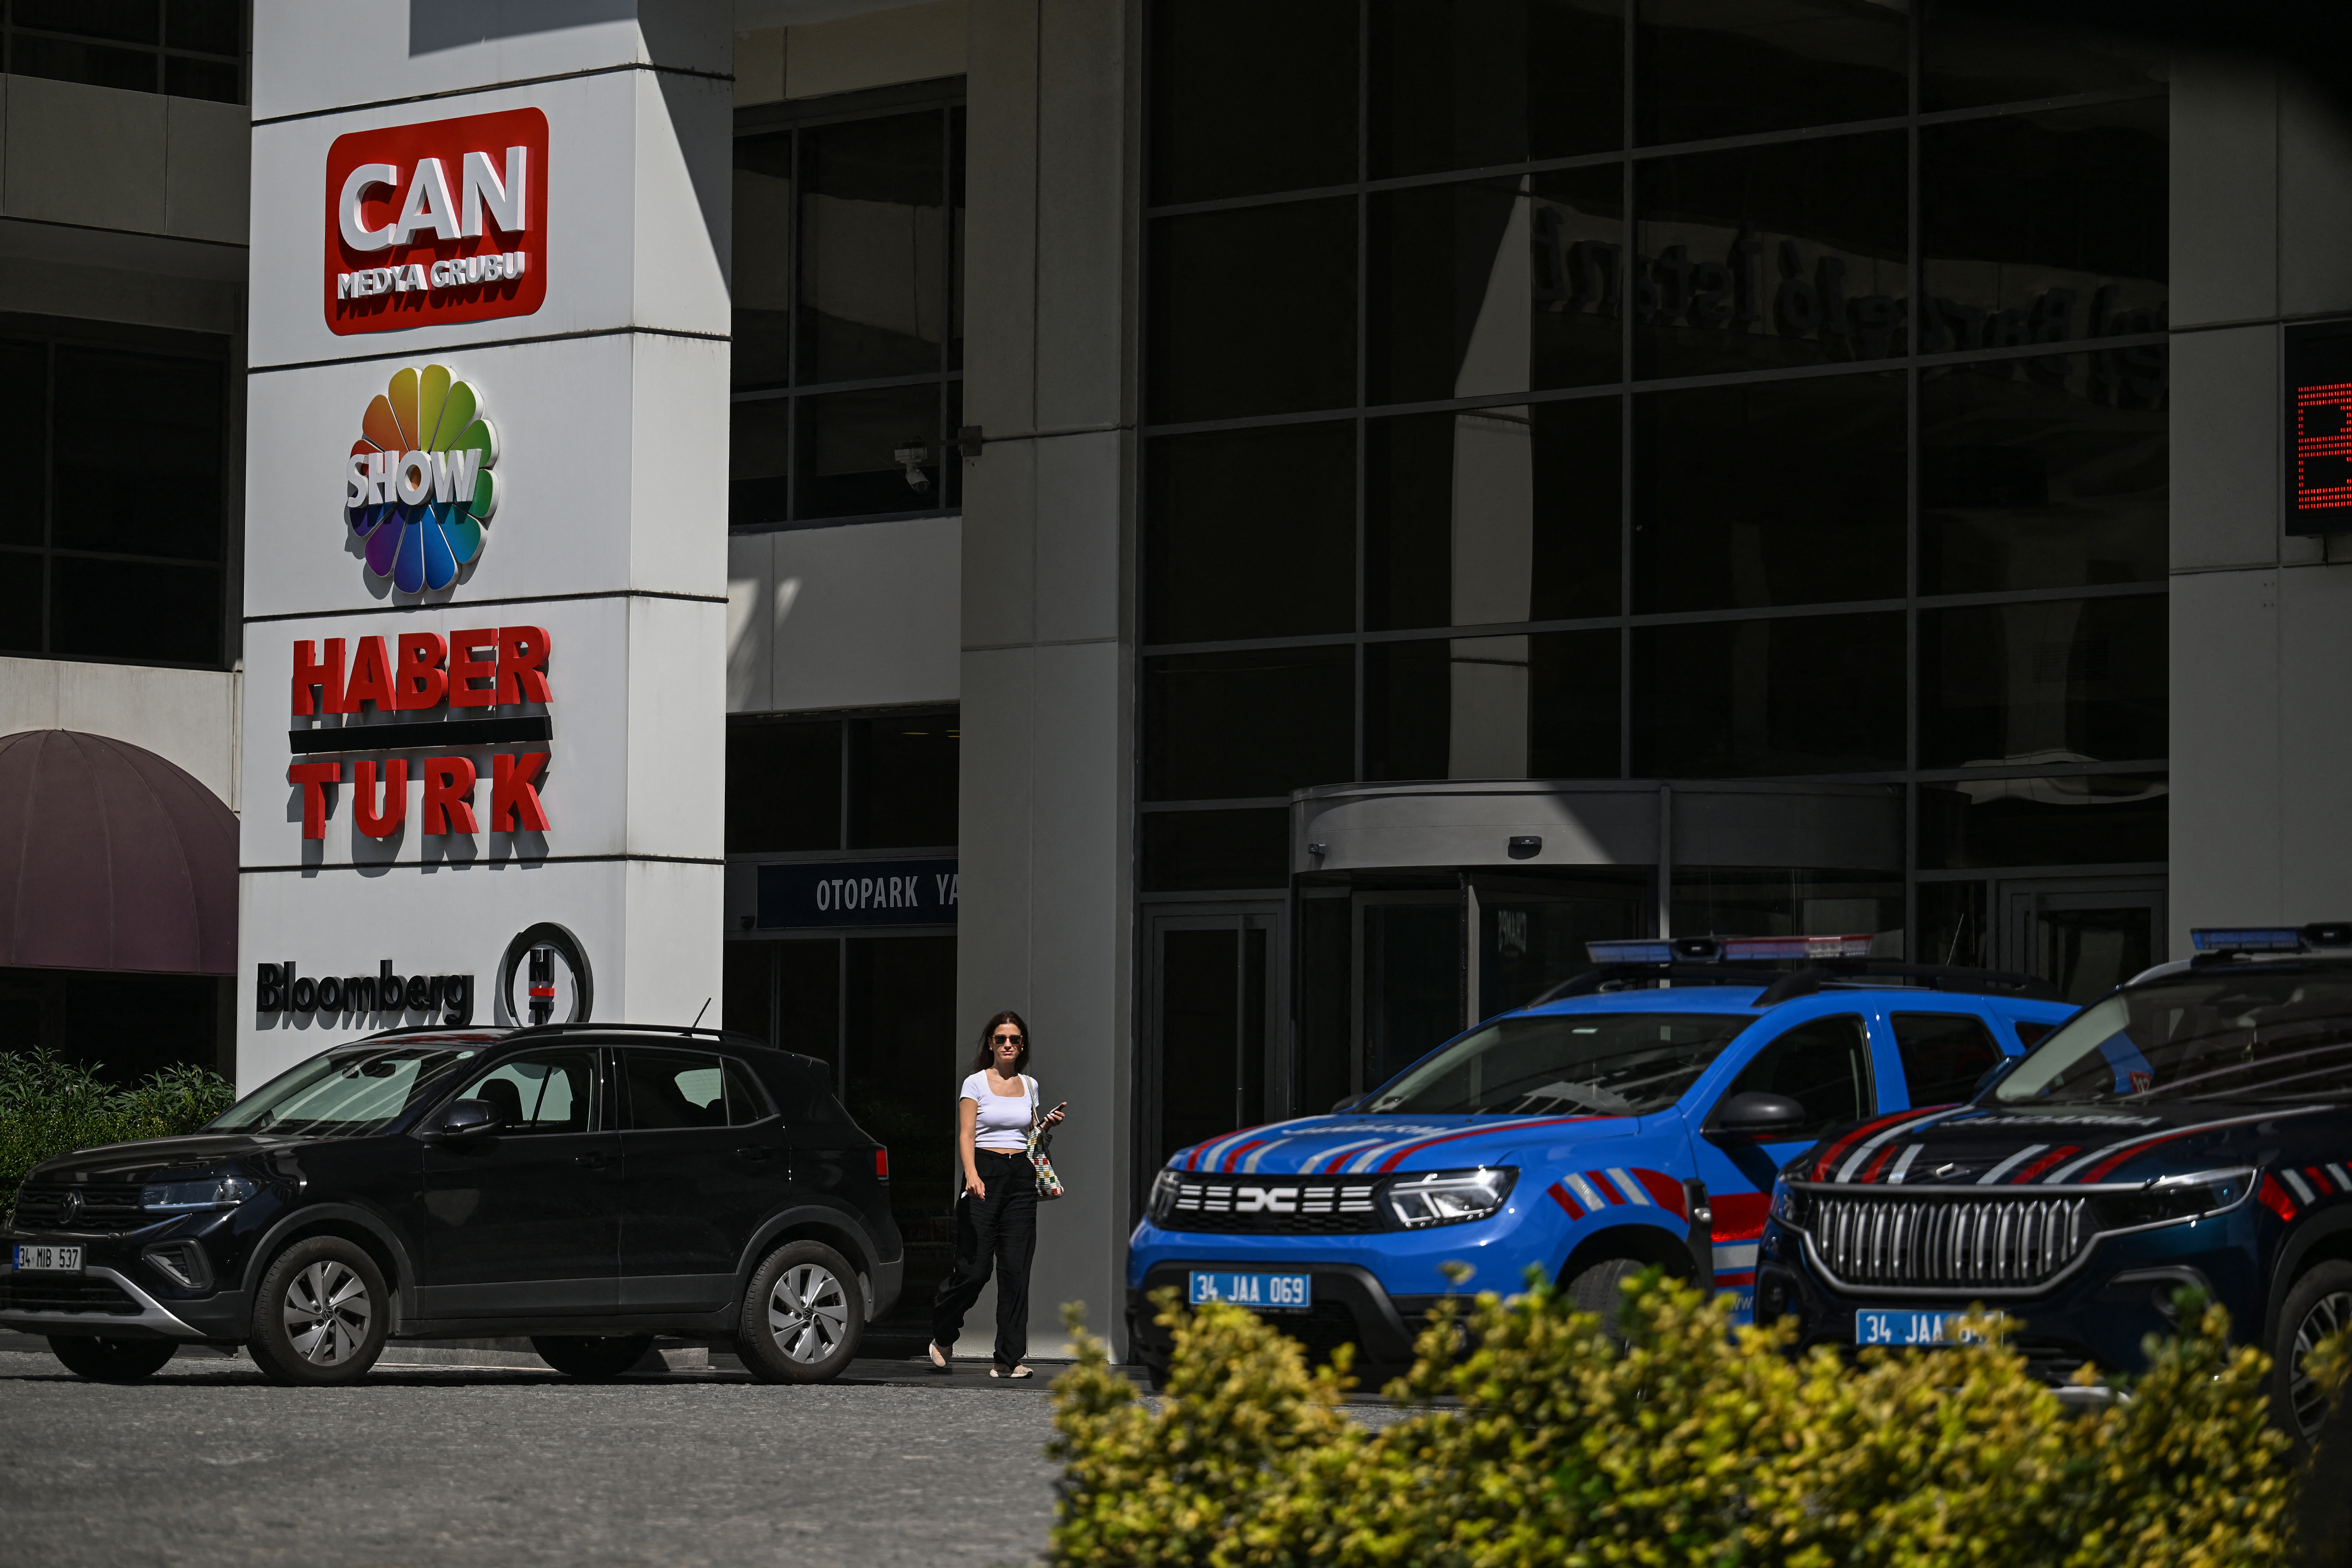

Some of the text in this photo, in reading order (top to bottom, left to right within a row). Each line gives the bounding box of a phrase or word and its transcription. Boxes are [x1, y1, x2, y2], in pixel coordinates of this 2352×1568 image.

[339, 145, 527, 252] CAN
[337, 251, 525, 299] MEDYA GRUBU
[346, 448, 482, 509] SHOW
[293, 625, 553, 716] HABER
[290, 752, 551, 839] TURK
[816, 875, 918, 911] OTOPARK
[257, 959, 474, 1025] Bloomberg
[19, 1248, 78, 1268] 34 MIB 537
[1196, 1274, 1305, 1304] 34 JAA 069
[1866, 1314, 1892, 1343] 34
[1905, 1314, 1944, 1343] JAA
